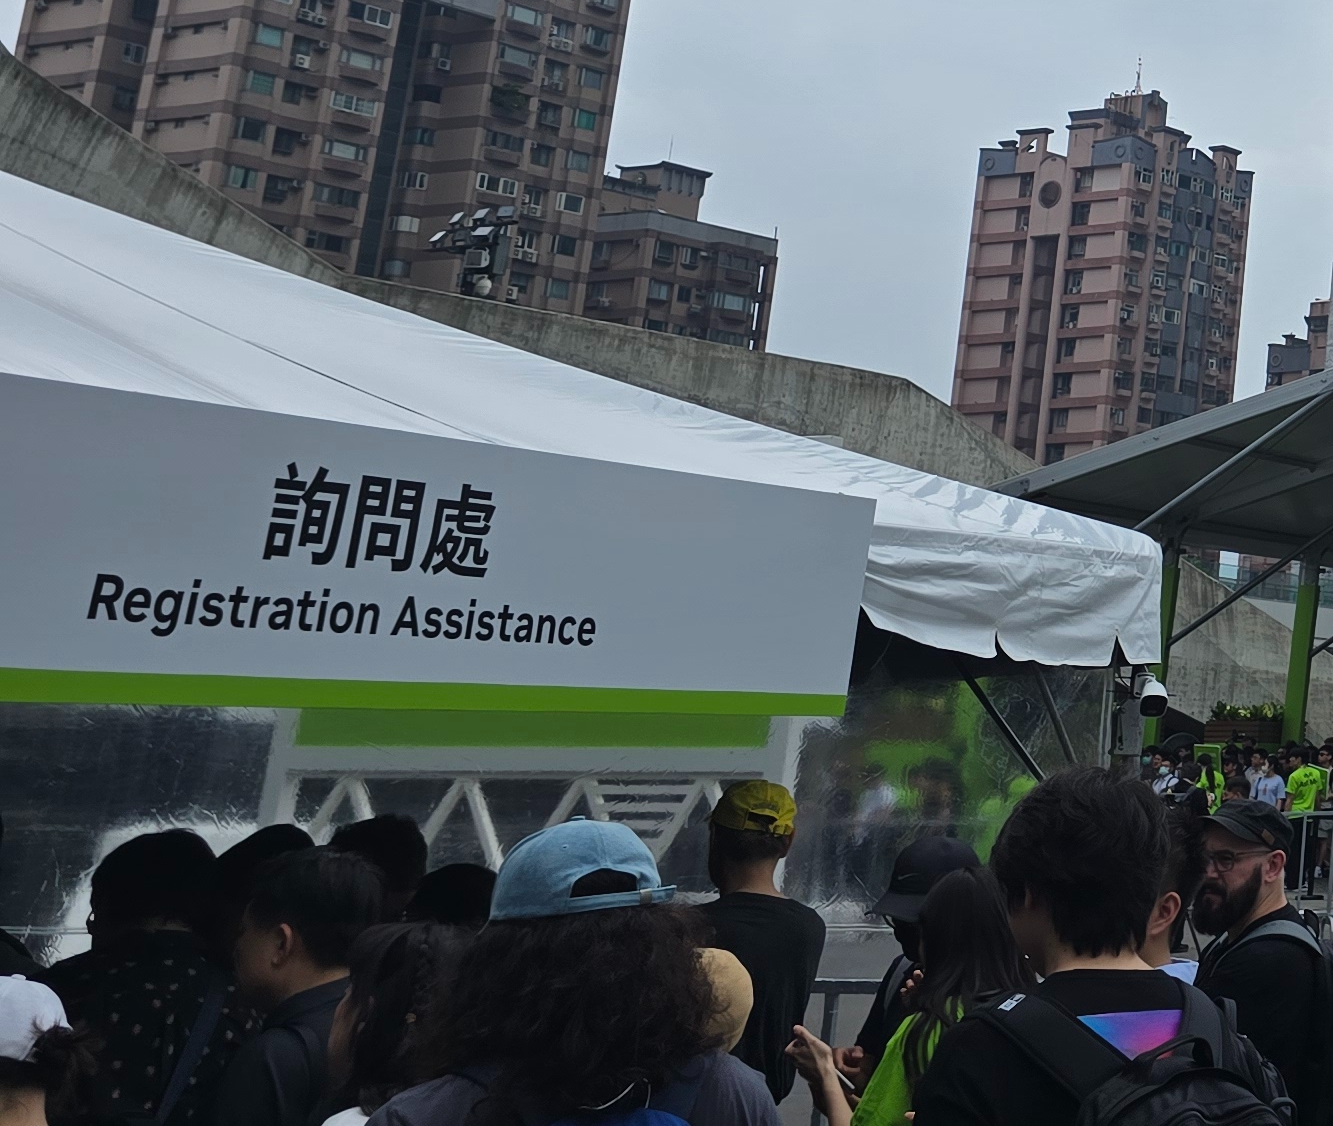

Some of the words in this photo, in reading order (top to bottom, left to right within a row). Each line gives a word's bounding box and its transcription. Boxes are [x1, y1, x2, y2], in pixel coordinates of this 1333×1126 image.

[262, 462, 496, 578] 詢問處
[86, 573, 380, 637] Registration
[391, 595, 596, 647] Assistance
